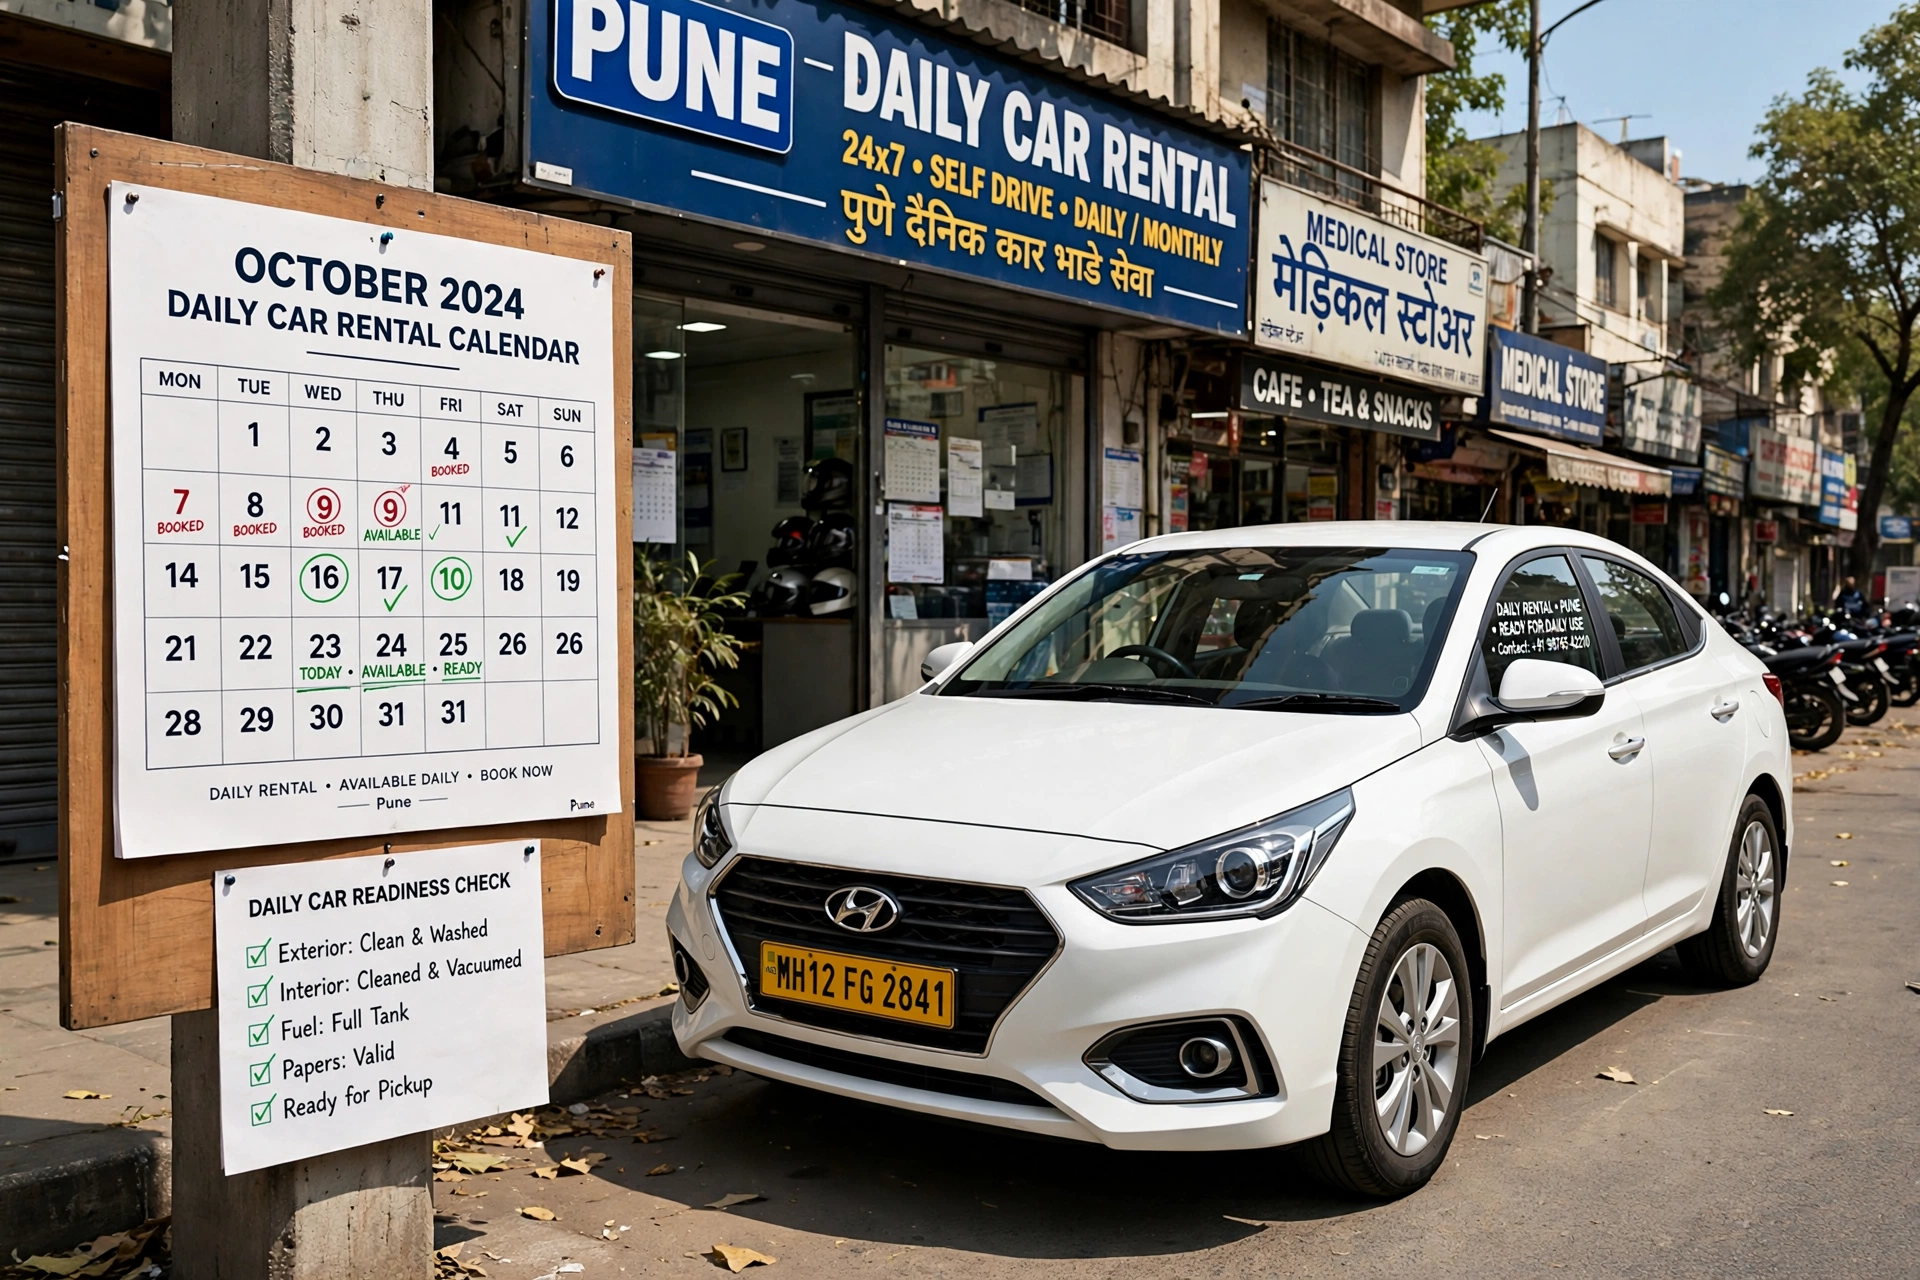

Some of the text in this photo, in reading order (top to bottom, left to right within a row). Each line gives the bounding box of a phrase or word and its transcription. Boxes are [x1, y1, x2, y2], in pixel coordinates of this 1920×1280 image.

[572, 0, 780, 132] PUNE
[844, 32, 1235, 228] DAILY CAR RENTAL
[843, 130, 904, 176] 24x7
[931, 155, 985, 198] SELF
[992, 172, 1053, 219] DRIVE
[1075, 197, 1126, 238] DAILY
[1144, 218, 1222, 266] MONTHLY
[841, 184, 1154, 297] पुणे दैनिक कार भाडे सेवा
[1307, 210, 1447, 285] MEDICAL STORE
[235, 247, 524, 319] OCTOBER 2024
[169, 289, 579, 365] DAILY CAR RENTAL CALENDAR
[160, 371, 580, 422] MON TUE WED THU FRI SAT SUN
[1253, 367, 1432, 431] CAFE TEA & SNACKS
[1501, 345, 1562, 404] MEDICAL
[1565, 364, 1605, 414] STORE
[247, 422, 573, 467] 1 2 3 4 5 6
[432, 464, 469, 477] BOOKED
[158, 520, 421, 542] BOOKED BOOKED BOOKED AVAILABLE
[174, 489, 578, 529] 7 8 9 9 11 11 12
[166, 562, 579, 591] 14 15 16 17 10 18 19
[1496, 599, 1581, 616] DAILY RENTAL PUNE
[1499, 617, 1584, 636] READY FOR DAILY USE
[166, 632, 582, 661] 21 22 23 24 25 26 26
[300, 661, 483, 680] TODAY AVAILABLE READY
[165, 700, 465, 736] 28 29 30 31 31
[210, 765, 552, 800] DAILY RENTAL AVAILABLE DAILY BOOK NOW
[377, 797, 411, 810] Pune
[249, 872, 510, 917] DAILY CAR READINESS CHECK
[279, 918, 487, 963] Exterior: Clean & Washed
[281, 949, 521, 1001] Interior: Cleaned & Vacuumed
[777, 955, 944, 1017] MH12 FG 2841
[282, 1002, 409, 1040] Fuel: Full Tank
[283, 1041, 394, 1082] Papers: Valid
[284, 1075, 432, 1118] Ready for Pickup
